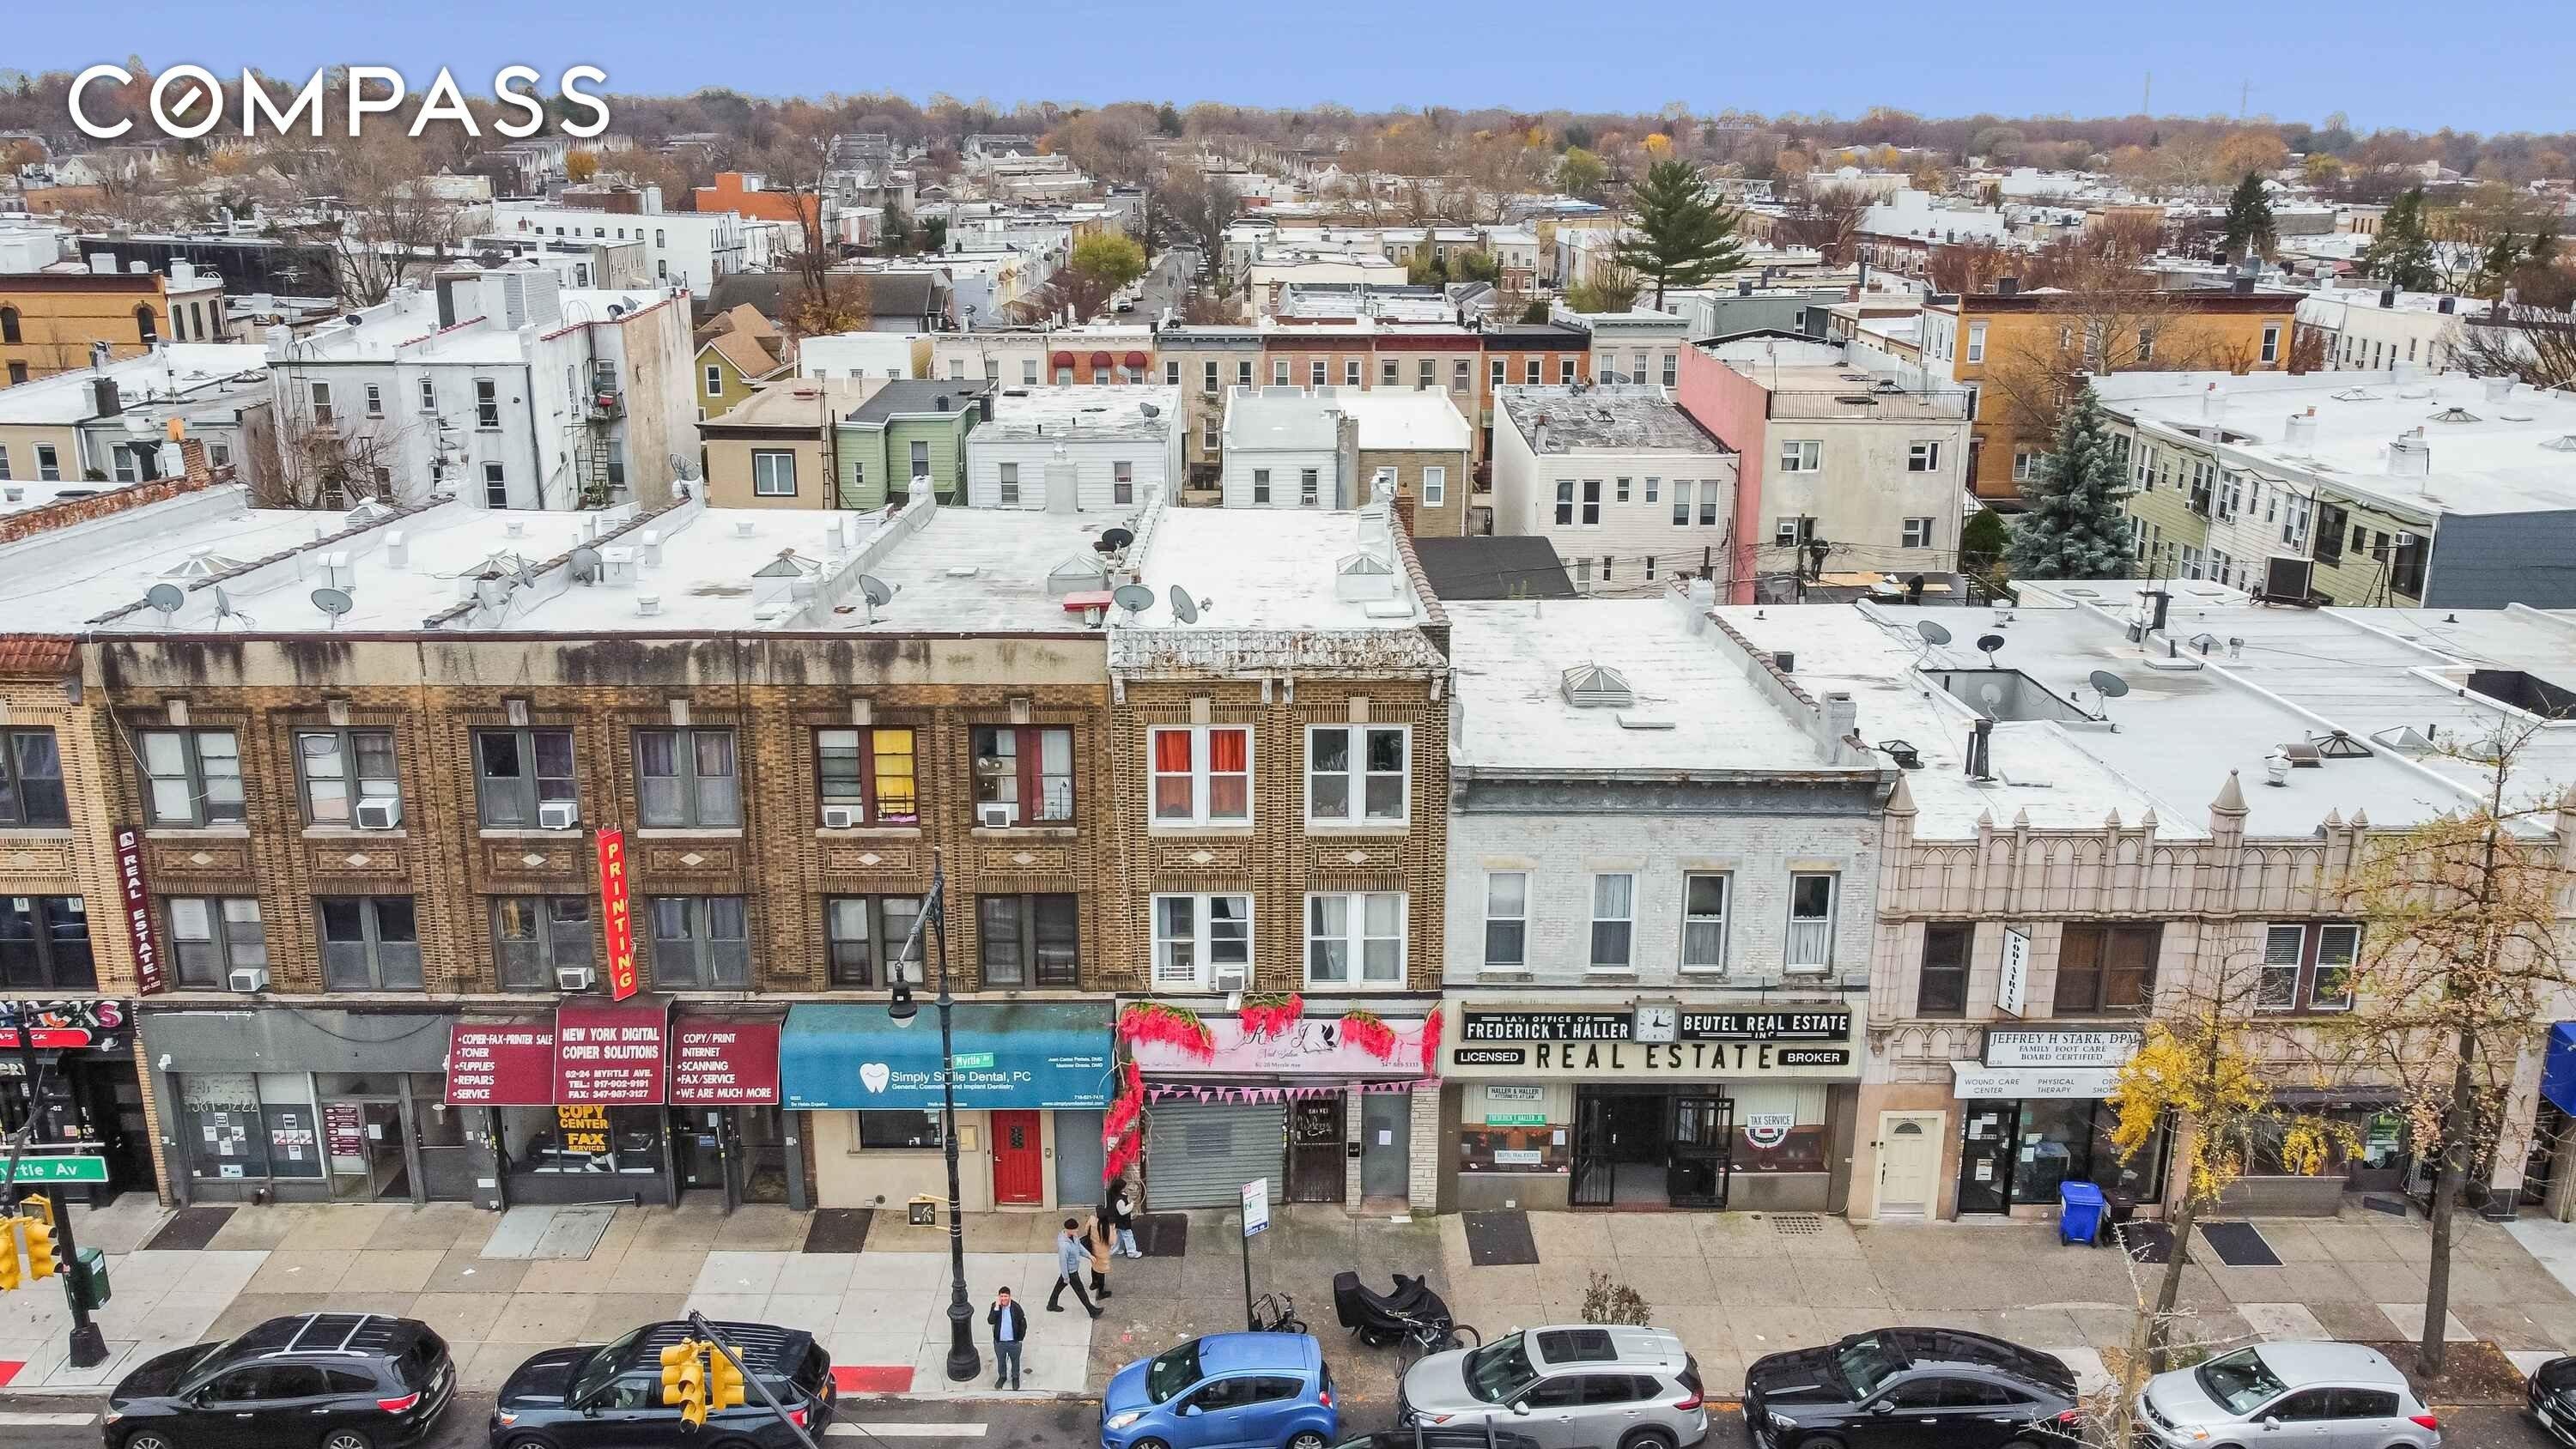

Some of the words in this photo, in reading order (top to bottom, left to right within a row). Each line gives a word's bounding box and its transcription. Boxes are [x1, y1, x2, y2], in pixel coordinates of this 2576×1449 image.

[124, 854, 142, 900] REAL
[133, 908, 158, 975] ESTATE
[608, 842, 632, 988] PRINTING
[2008, 937, 2021, 1009] PODIATRIST
[1683, 1016, 1738, 1030] BEUTEL
[1747, 1016, 1784, 1030] REAL
[1793, 1016, 1847, 1030] ESTATE
[562, 1028, 586, 1041] NEW
[591, 1028, 617, 1041] YORK
[622, 1028, 660, 1040] DIGITAL
[1467, 1023, 1550, 1039] FREDERICK
[1557, 1024, 1567, 1038] T.
[1573, 1024, 1628, 1038] HALLER
[536, 1034, 553, 1045] SALE
[1991, 1034, 2044, 1046] JEFFREY
[2049, 1034, 2058, 1044] H
[2063, 1034, 2105, 1045] STARK,
[2110, 1034, 2137, 1044] DPM
[461, 1048, 489, 1058] TONER
[562, 1046, 600, 1059] COPIER
[604, 1045, 659, 1059] SOLUTIONS
[683, 1047, 720, 1057] INTERNET
[1461, 1052, 1519, 1062] LICENSED
[1537, 1044, 1625, 1069] REAL
[1647, 1044, 1773, 1069] ESTATE
[1788, 1052, 1840, 1063] BROKER
[682, 1061, 728, 1071] SCANNING
[956, 1055, 981, 1066] Myrtle
[459, 1062, 495, 1071] SUPPLIES
[633, 1069, 653, 1077] AVE.
[891, 1071, 930, 1083] Simply
[934, 1071, 965, 1082] Sile
[969, 1071, 1009, 1082] Dental,
[1013, 1071, 1030, 1082] PC
[458, 1075, 495, 1085] REPAIRS
[457, 1089, 490, 1099] SERVICE
[681, 1088, 695, 1098] WE
[696, 1088, 714, 1098] ARE
[717, 1088, 743, 1098] MUCH
[746, 1088, 772, 1098] MORE
[558, 1106, 605, 1119] COPY
[560, 1119, 609, 1129] CENTER
[1751, 1116, 1762, 1125] TAX
[1765, 1116, 1790, 1125] SERVICE
[568, 1133, 605, 1145] FAX
[56, 1165, 77, 1175] Av
